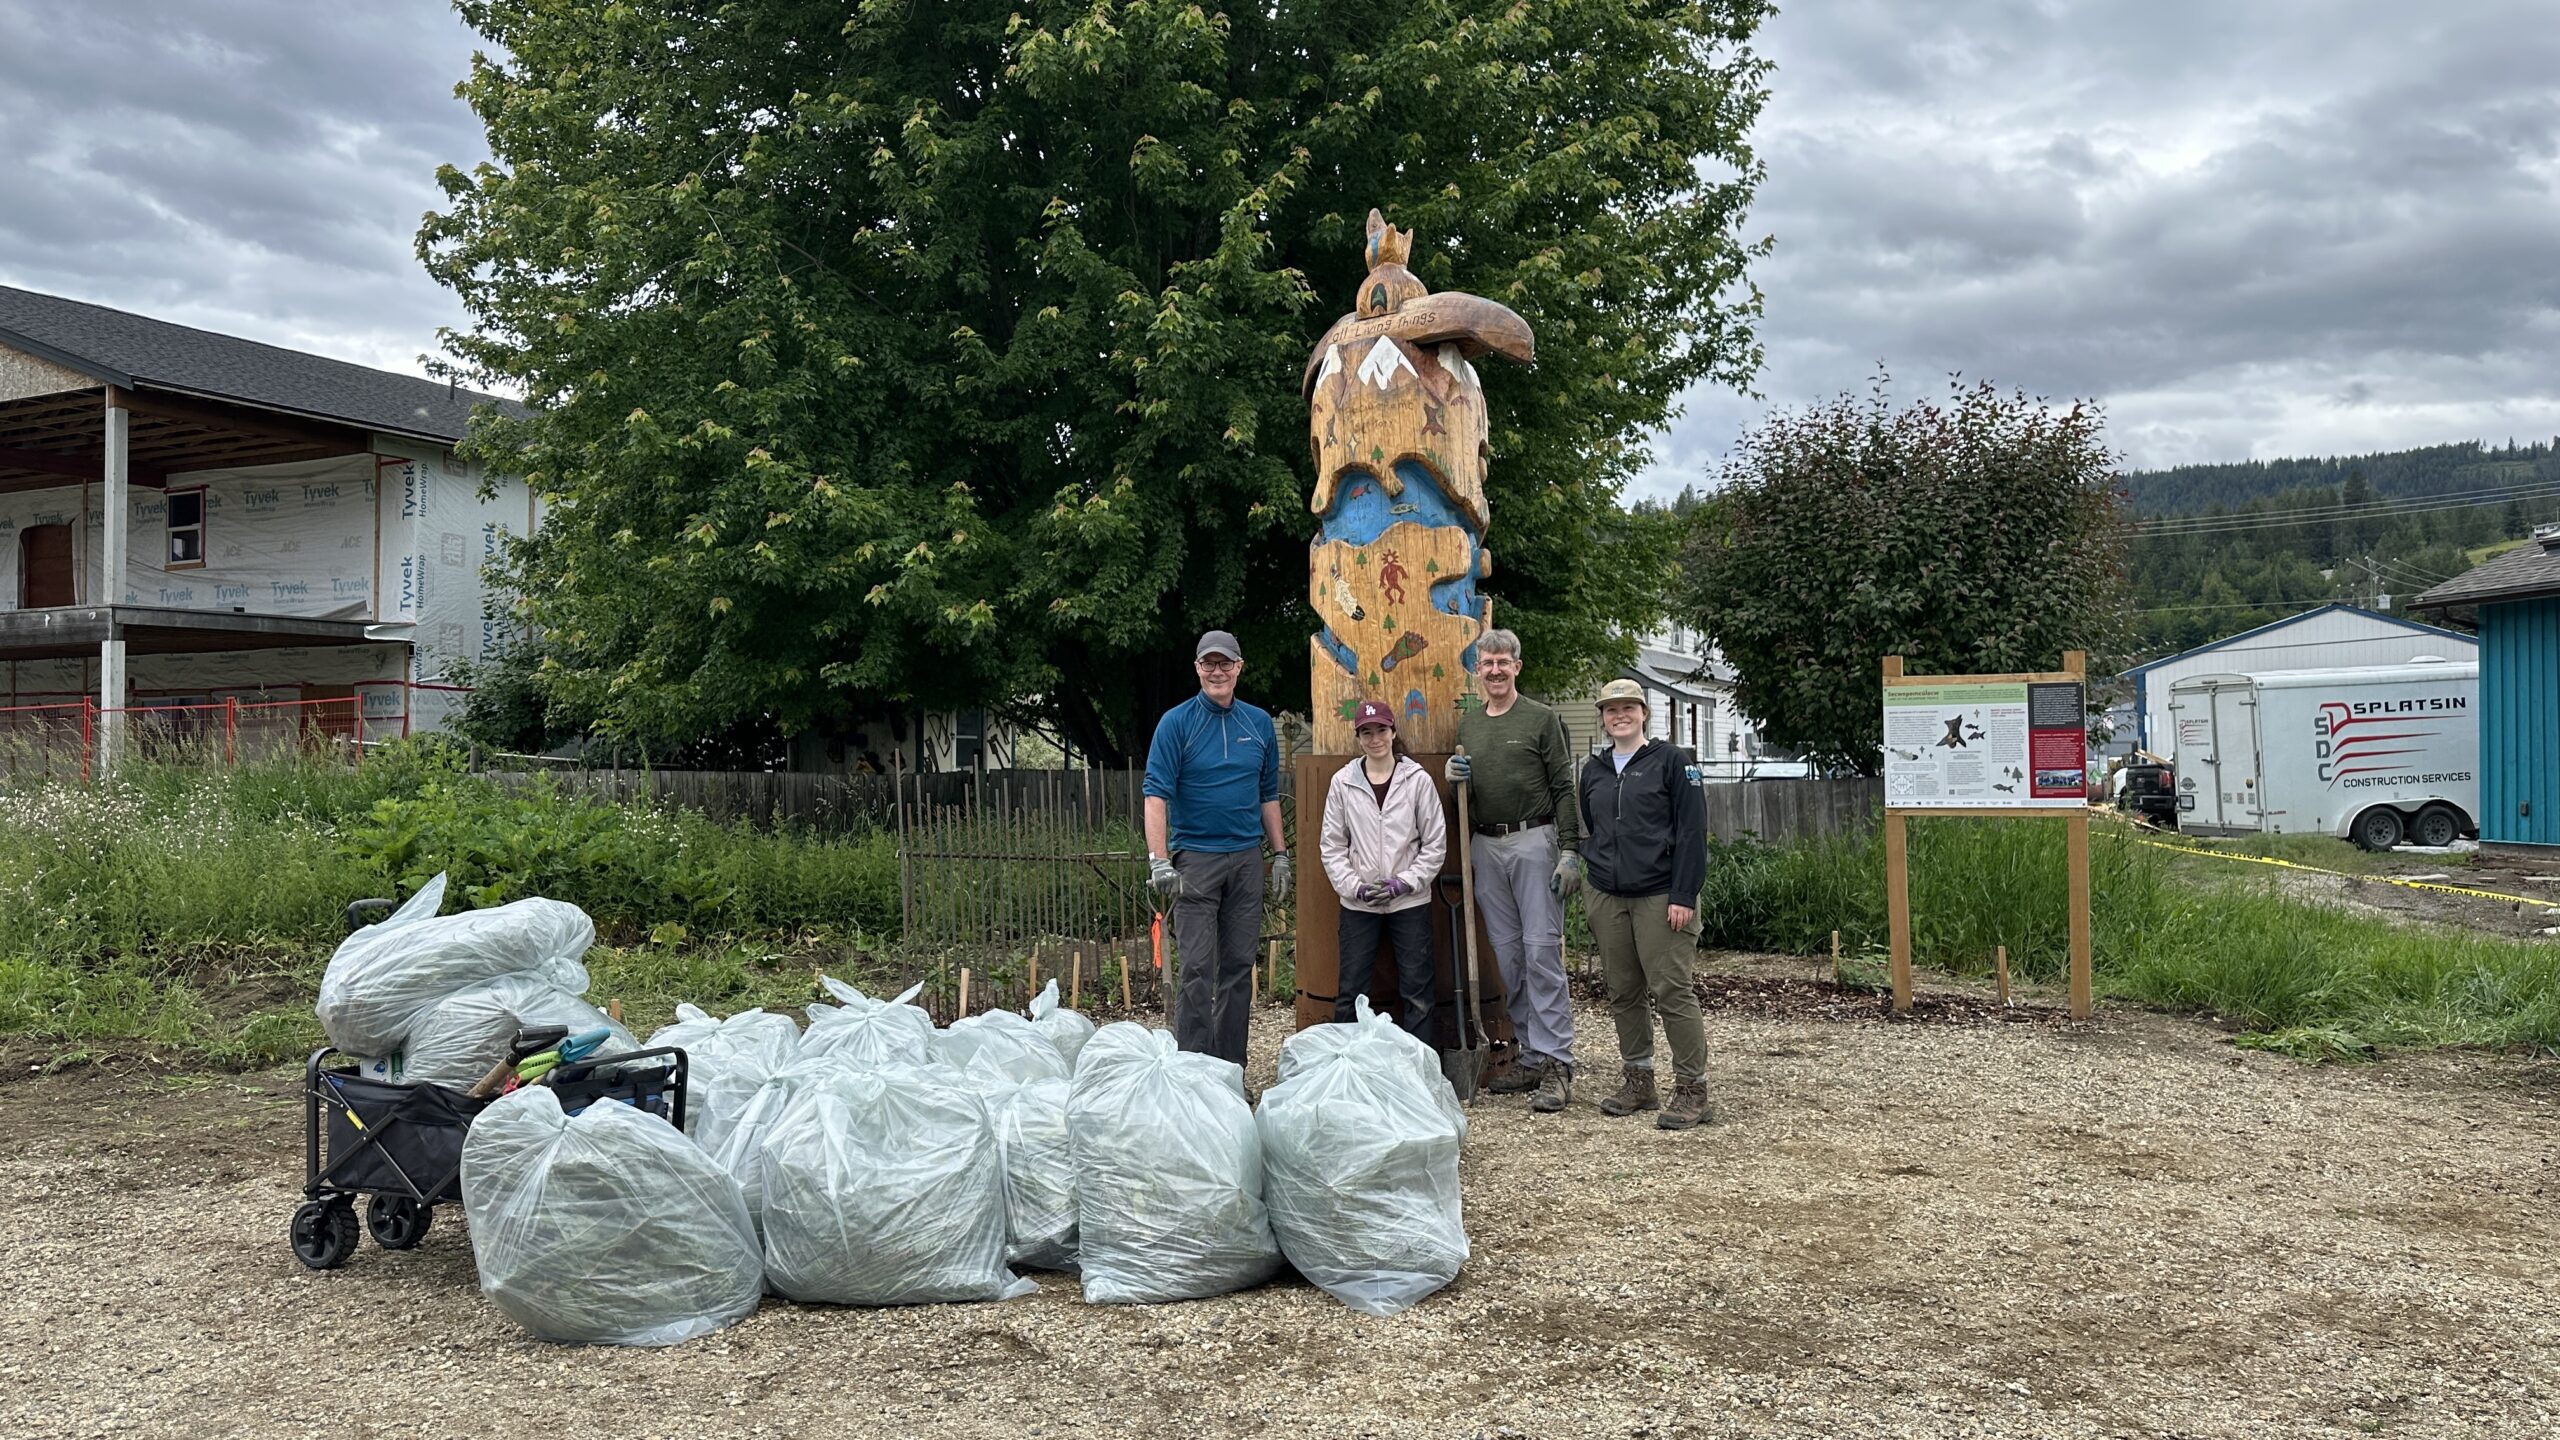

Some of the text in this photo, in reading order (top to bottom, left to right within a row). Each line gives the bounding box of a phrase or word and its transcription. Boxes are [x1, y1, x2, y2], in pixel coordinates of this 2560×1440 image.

[1355, 320, 1391, 338] Living
[243, 488, 280, 507] Tyvek
[302, 482, 340, 502] Tyvek
[402, 463, 417, 520] Tyvek
[419, 463, 429, 518] HomeWrap
[135, 500, 167, 517] Tyvek
[33, 512, 64, 525] Tyvek
[341, 535, 363, 549] ACE
[271, 580, 308, 598] Tyvek
[331, 577, 370, 595] Tyvek
[400, 556, 415, 612] Tyvek
[417, 555, 427, 609] HomeWrap
[159, 587, 193, 605] Tyvek
[214, 584, 250, 602] Tyvek
[362, 691, 400, 709] Tyvek
[2353, 696, 2467, 715] SPLATSIN
[1365, 705, 1376, 716] LA
[2343, 771, 2472, 789] CONSTRUCTION SERVICES
